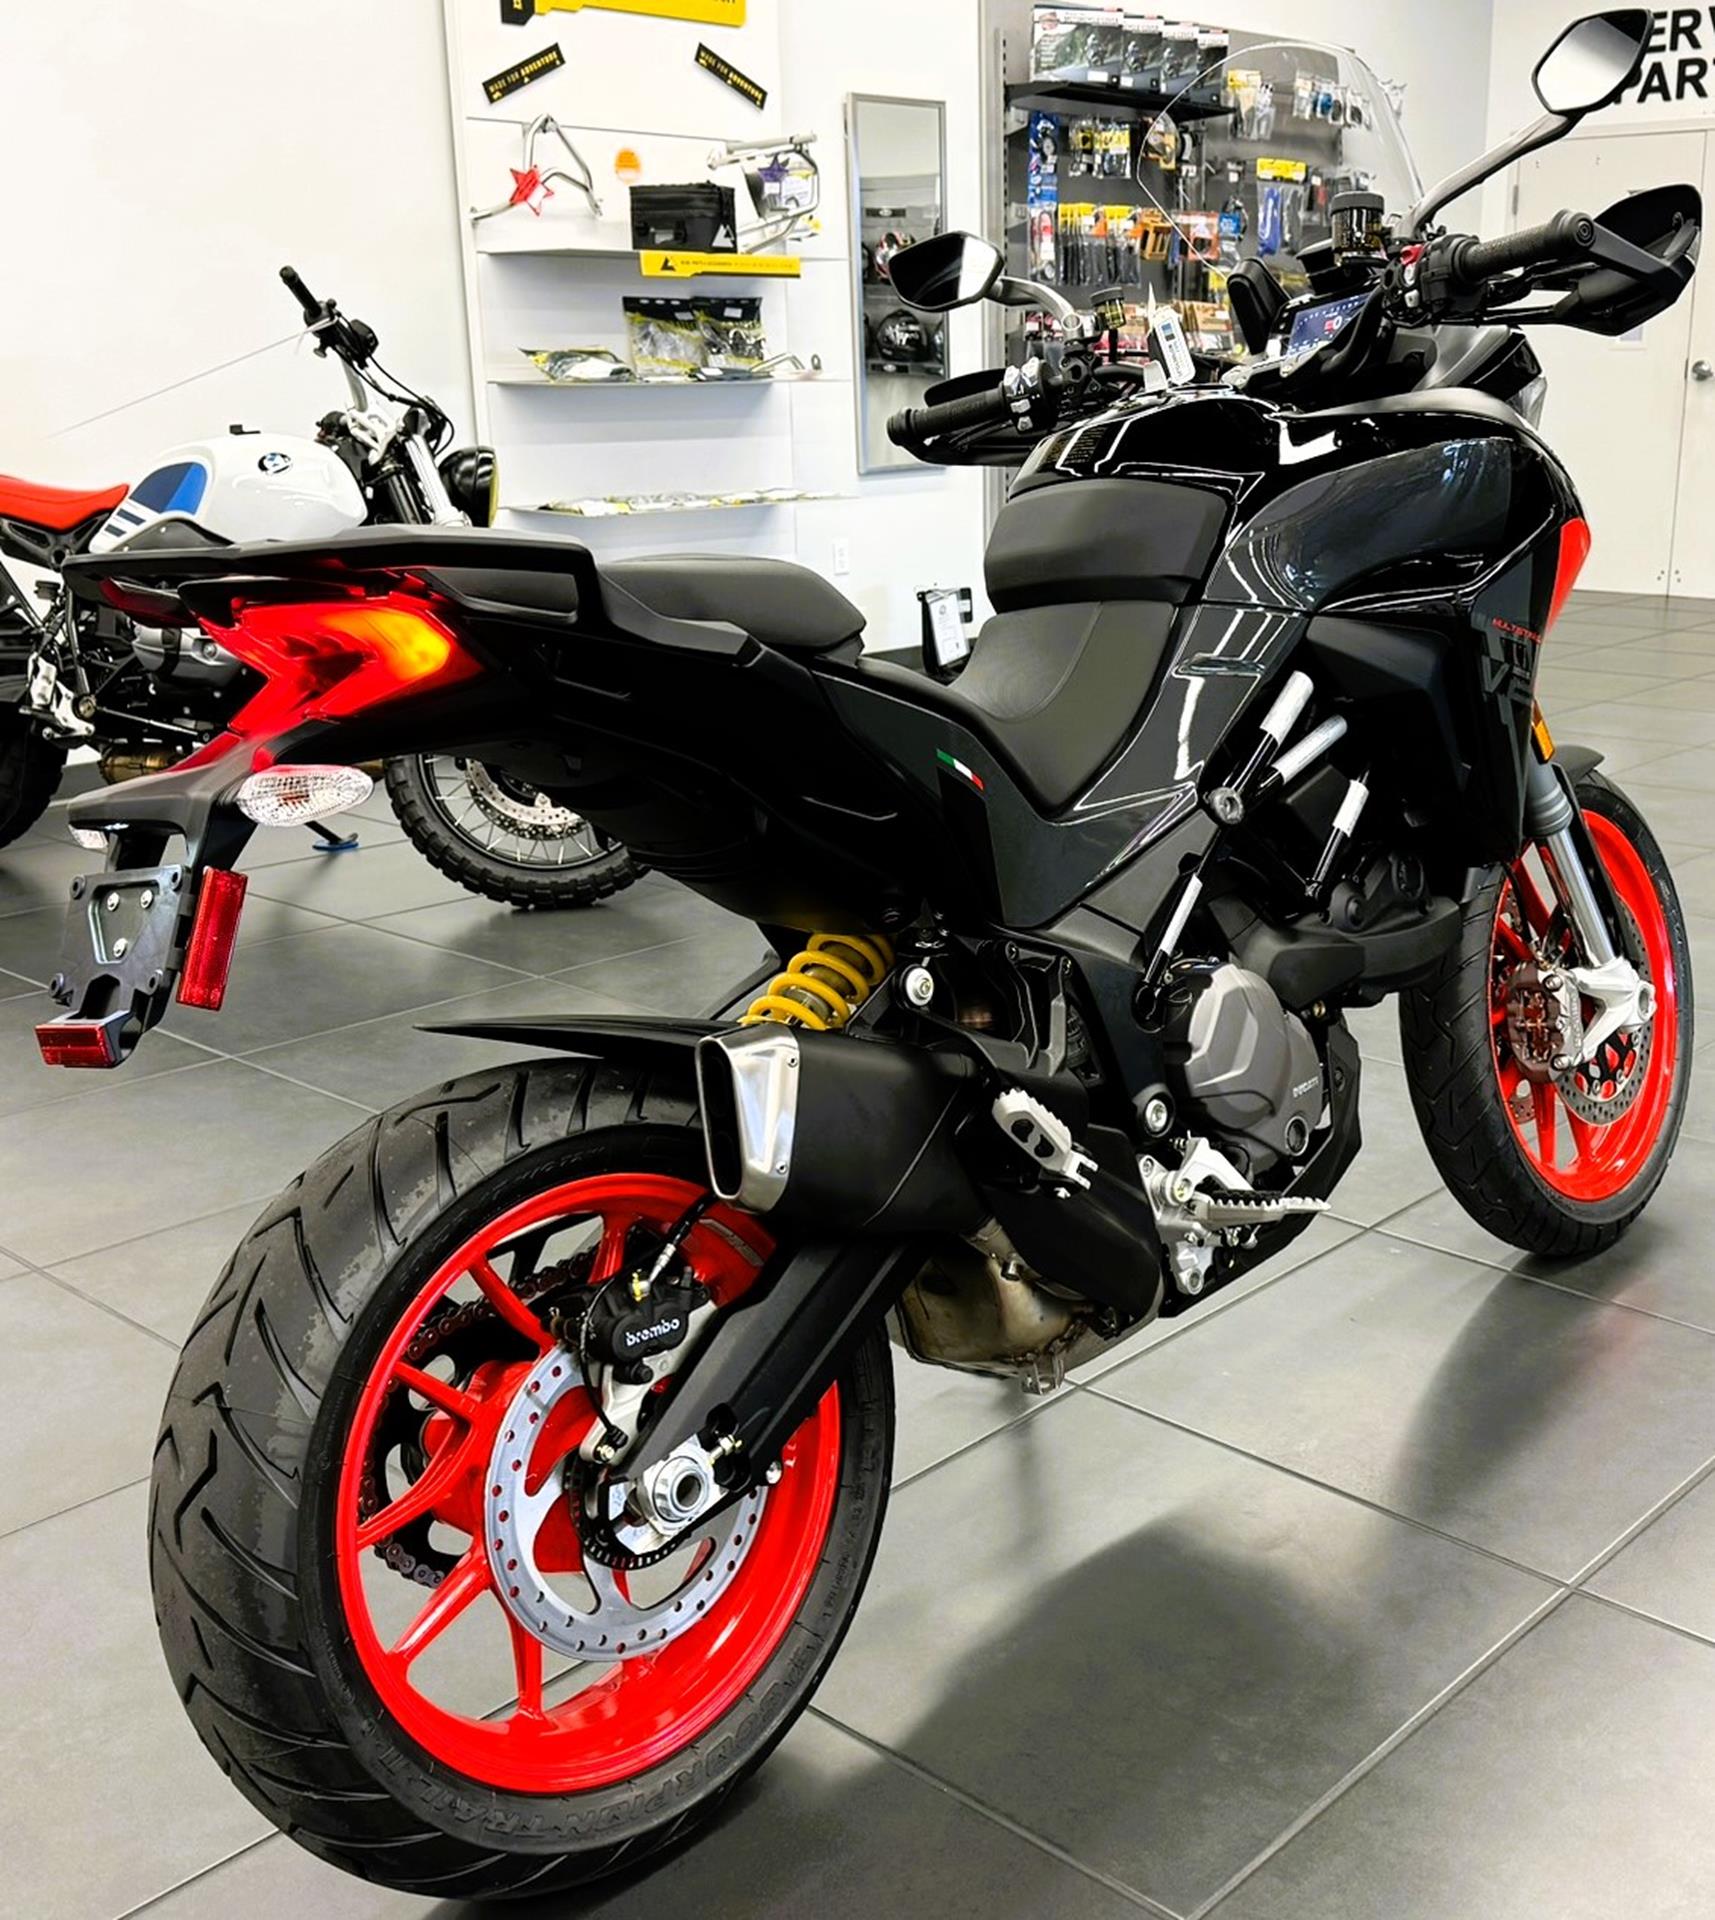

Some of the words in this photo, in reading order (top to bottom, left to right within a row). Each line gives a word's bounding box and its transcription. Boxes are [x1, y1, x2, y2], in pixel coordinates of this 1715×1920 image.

[1646, 6, 1715, 54] ER
[1292, 1076, 1319, 1098] DUCATI
[625, 1318, 681, 1347] brembo
[413, 1776, 545, 1838] TRAIL
